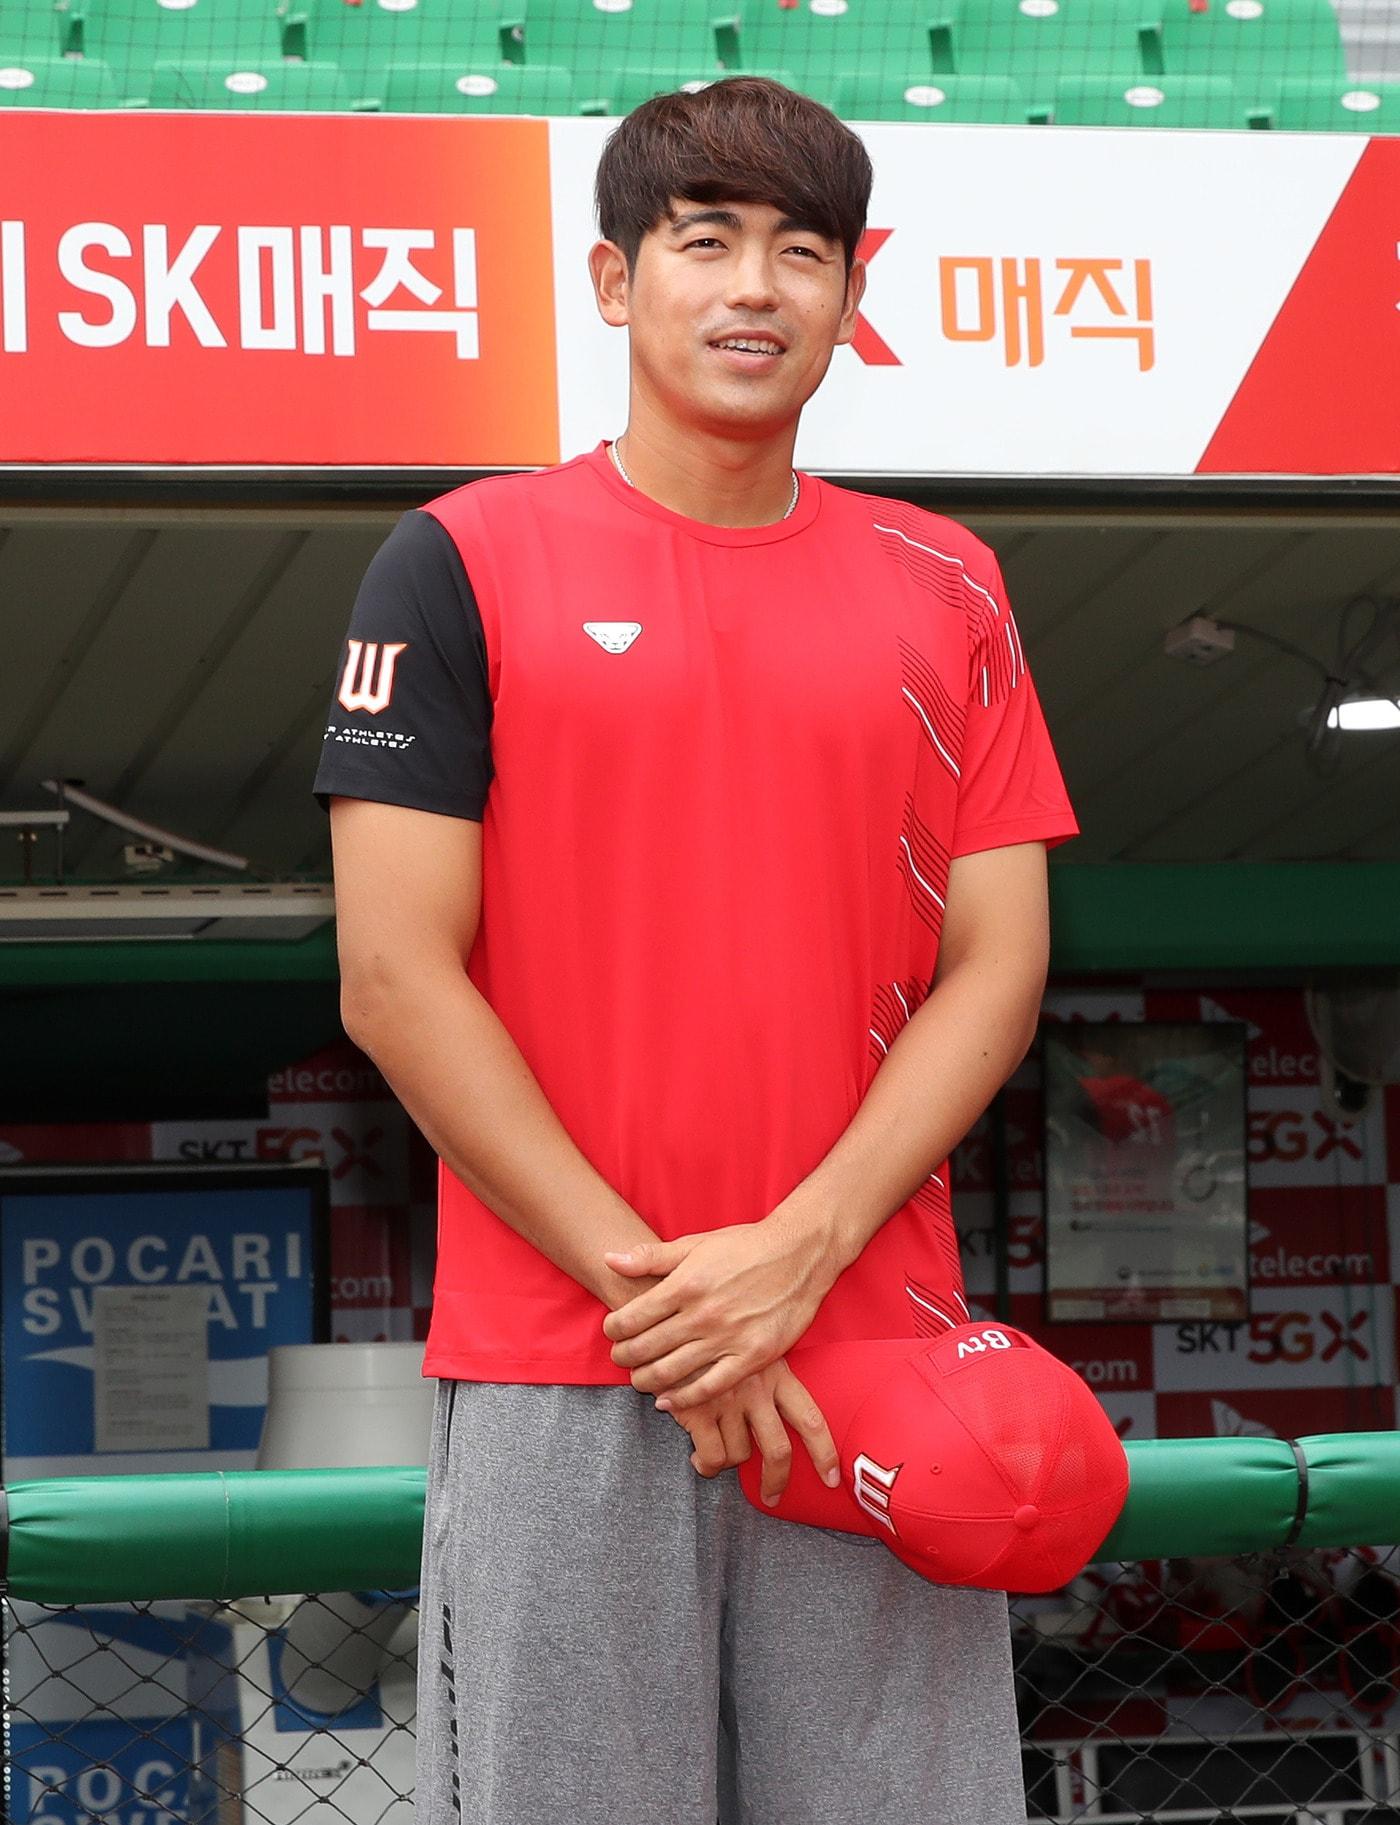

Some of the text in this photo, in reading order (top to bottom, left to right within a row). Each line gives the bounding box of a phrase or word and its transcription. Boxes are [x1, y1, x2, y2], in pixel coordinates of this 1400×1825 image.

[938, 255, 1156, 373] 매직
[335, 735, 410, 750] ATHLETES
[342, 727, 416, 743] ATHLETES
[22, 1232, 302, 1287] POCARI
[22, 1282, 280, 1337] SAT
[1176, 1309, 1370, 1365] SKT 5GX
[28, 1760, 179, 1815] POC
